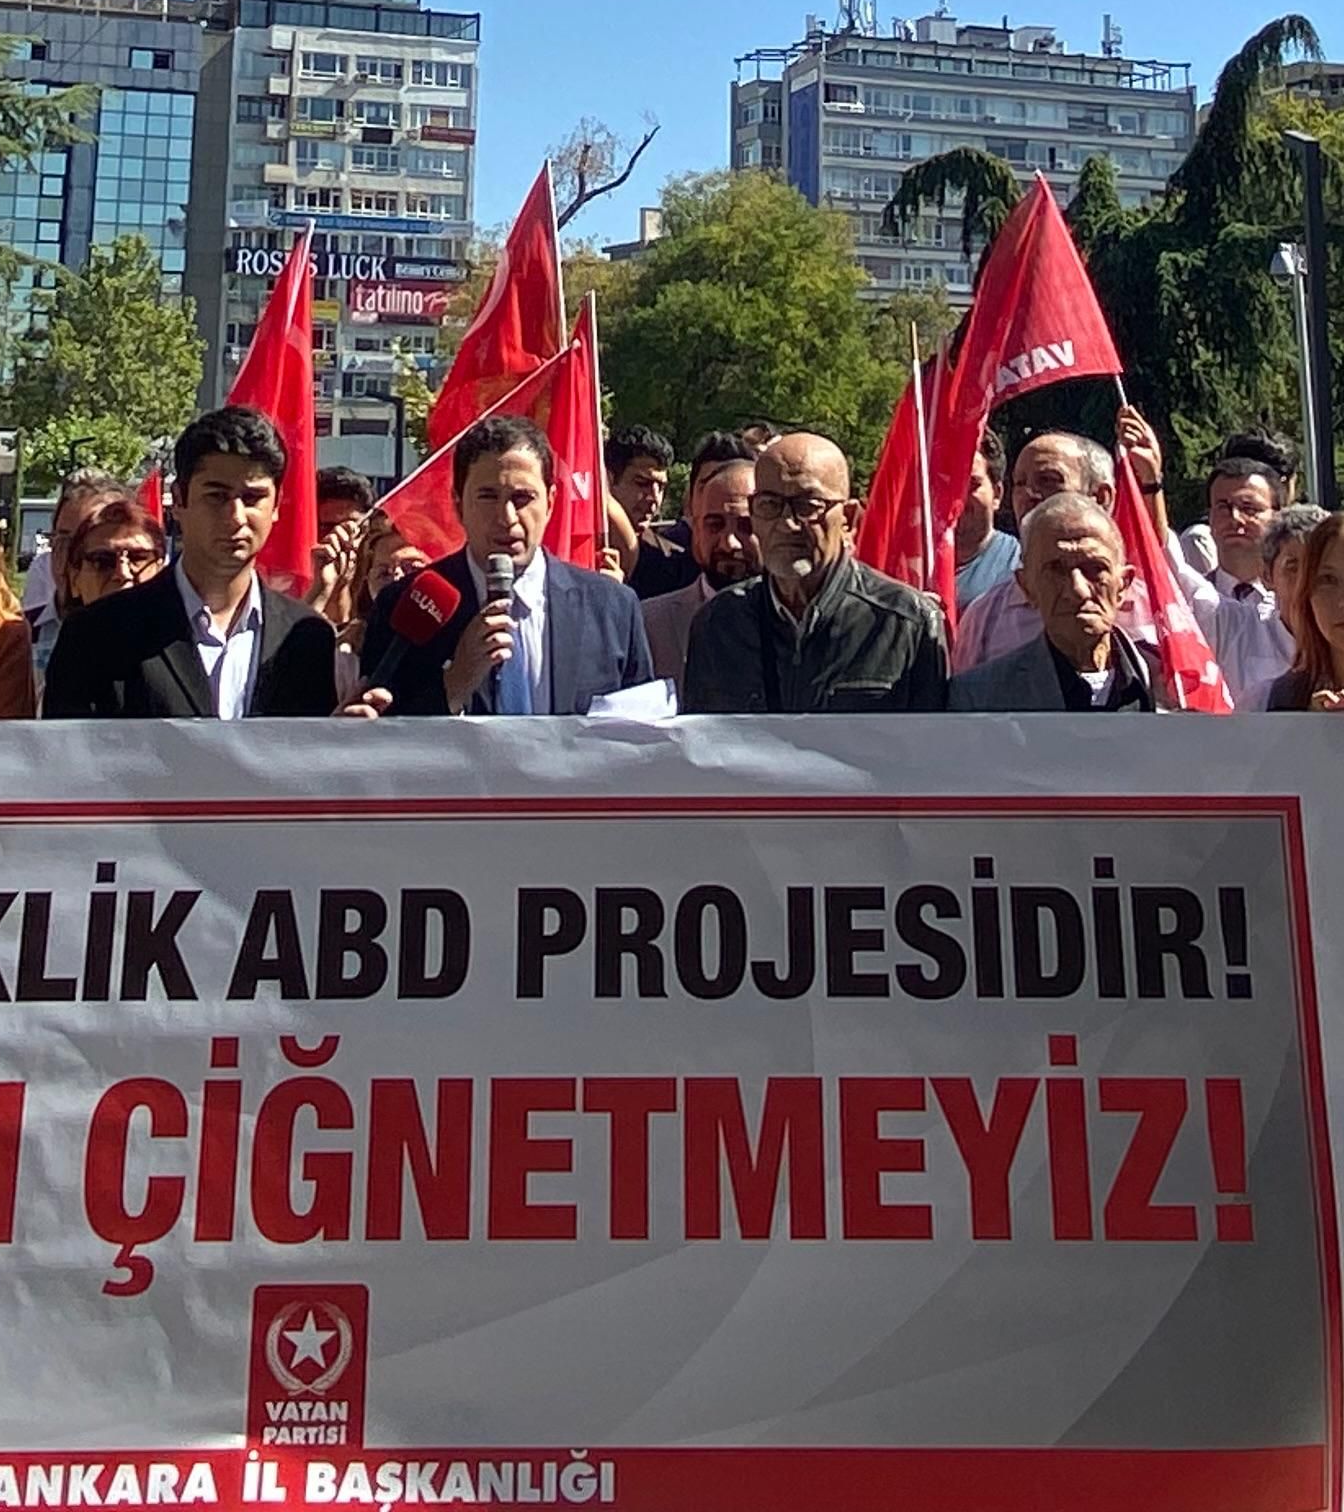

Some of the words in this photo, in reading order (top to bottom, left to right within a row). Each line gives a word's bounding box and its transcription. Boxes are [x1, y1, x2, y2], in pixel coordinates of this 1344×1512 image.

[327, 253, 387, 282] LUCK
[225, 886, 471, 1002] ABD
[515, 856, 1254, 1000] PROJESİDİR!
[84, 1034, 1254, 1296] ÇİĞNETMEYİZ!
[265, 1400, 348, 1423] VATAN
[262, 1424, 347, 1446] PARTİSİ
[241, 1448, 286, 1504] İL
[305, 1448, 615, 1512] BAŞKANLIĞI
